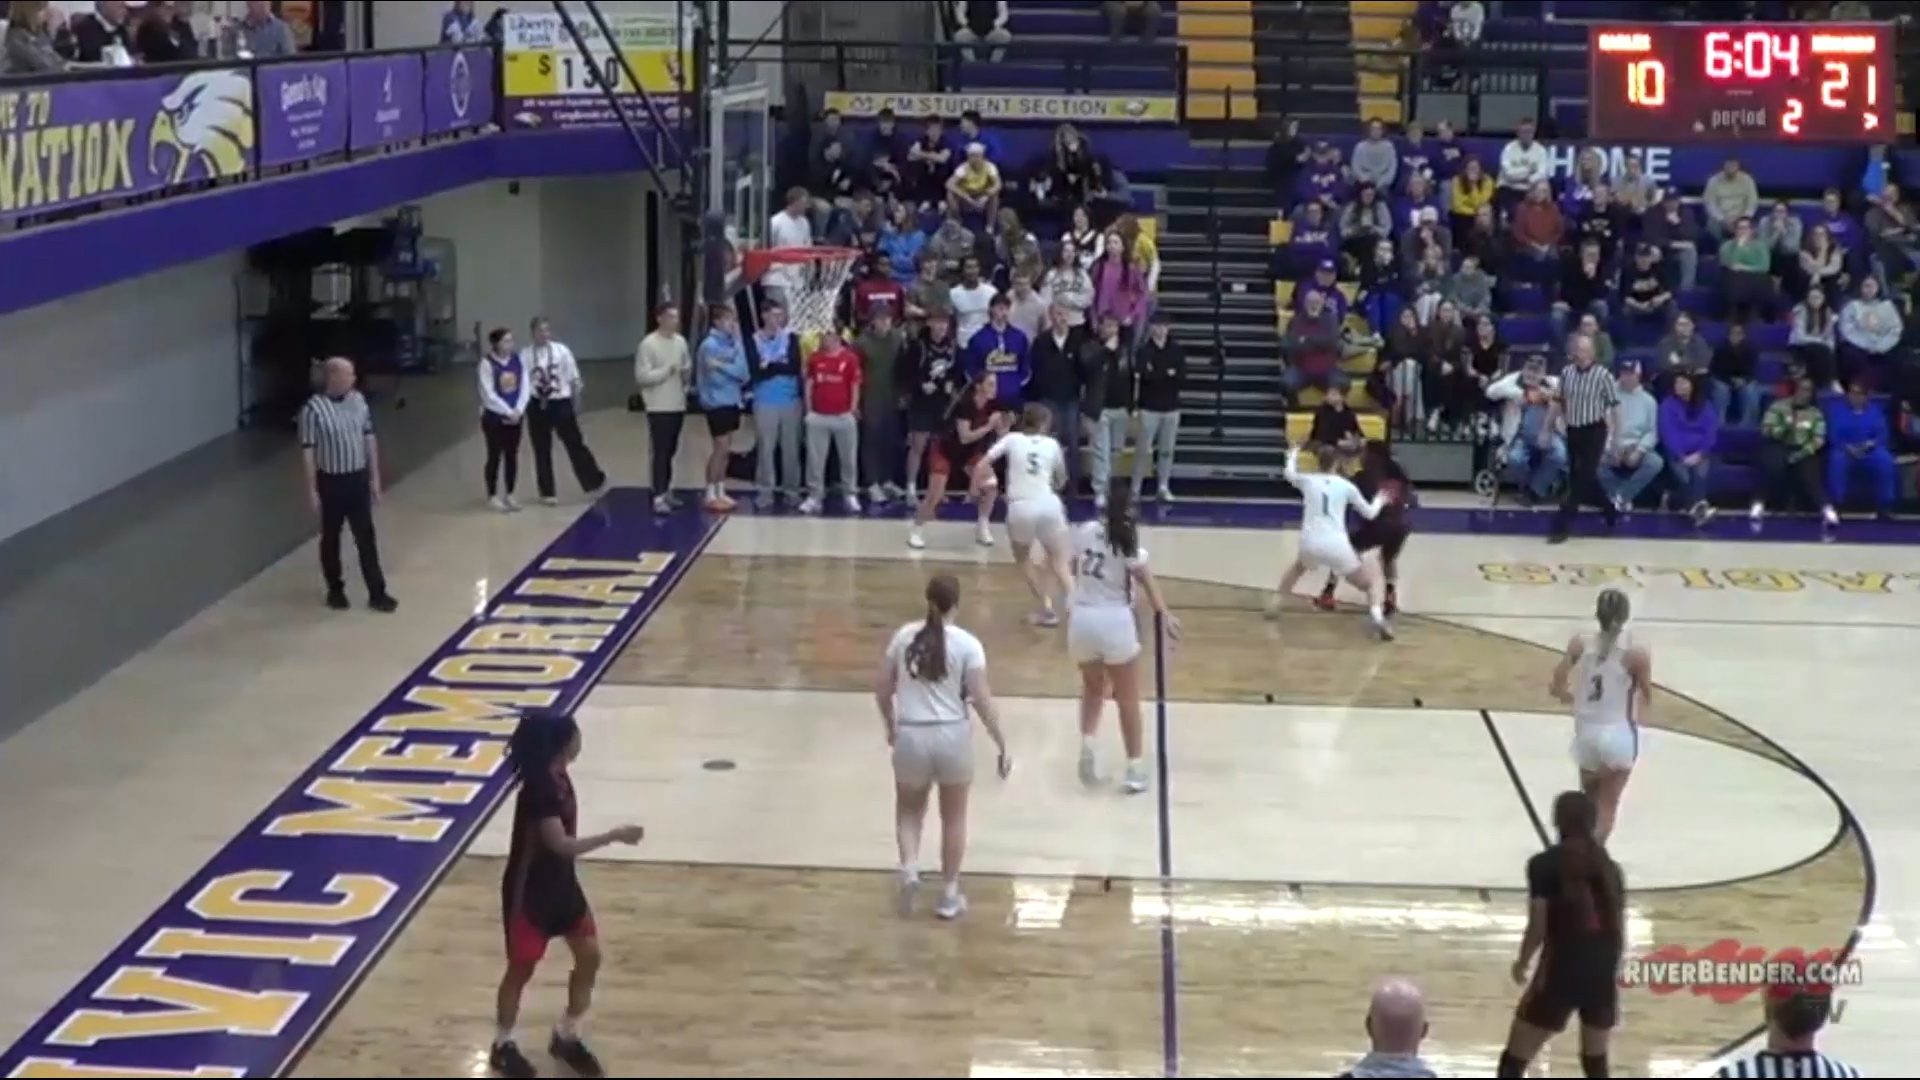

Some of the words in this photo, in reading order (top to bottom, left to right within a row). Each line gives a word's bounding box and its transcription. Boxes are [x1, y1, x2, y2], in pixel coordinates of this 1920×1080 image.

[1705, 31, 1800, 78] 6:04
[1628, 60, 1665, 106] 10
[27, 90, 50, 126] TO
[917, 97, 1012, 113] STUDENT
[1018, 97, 1108, 115] SECTION
[1711, 107, 1767, 130] period
[1782, 98, 1803, 135] 2
[1321, 491, 1330, 516] 1
[261, 551, 677, 842] MEMORIAL
